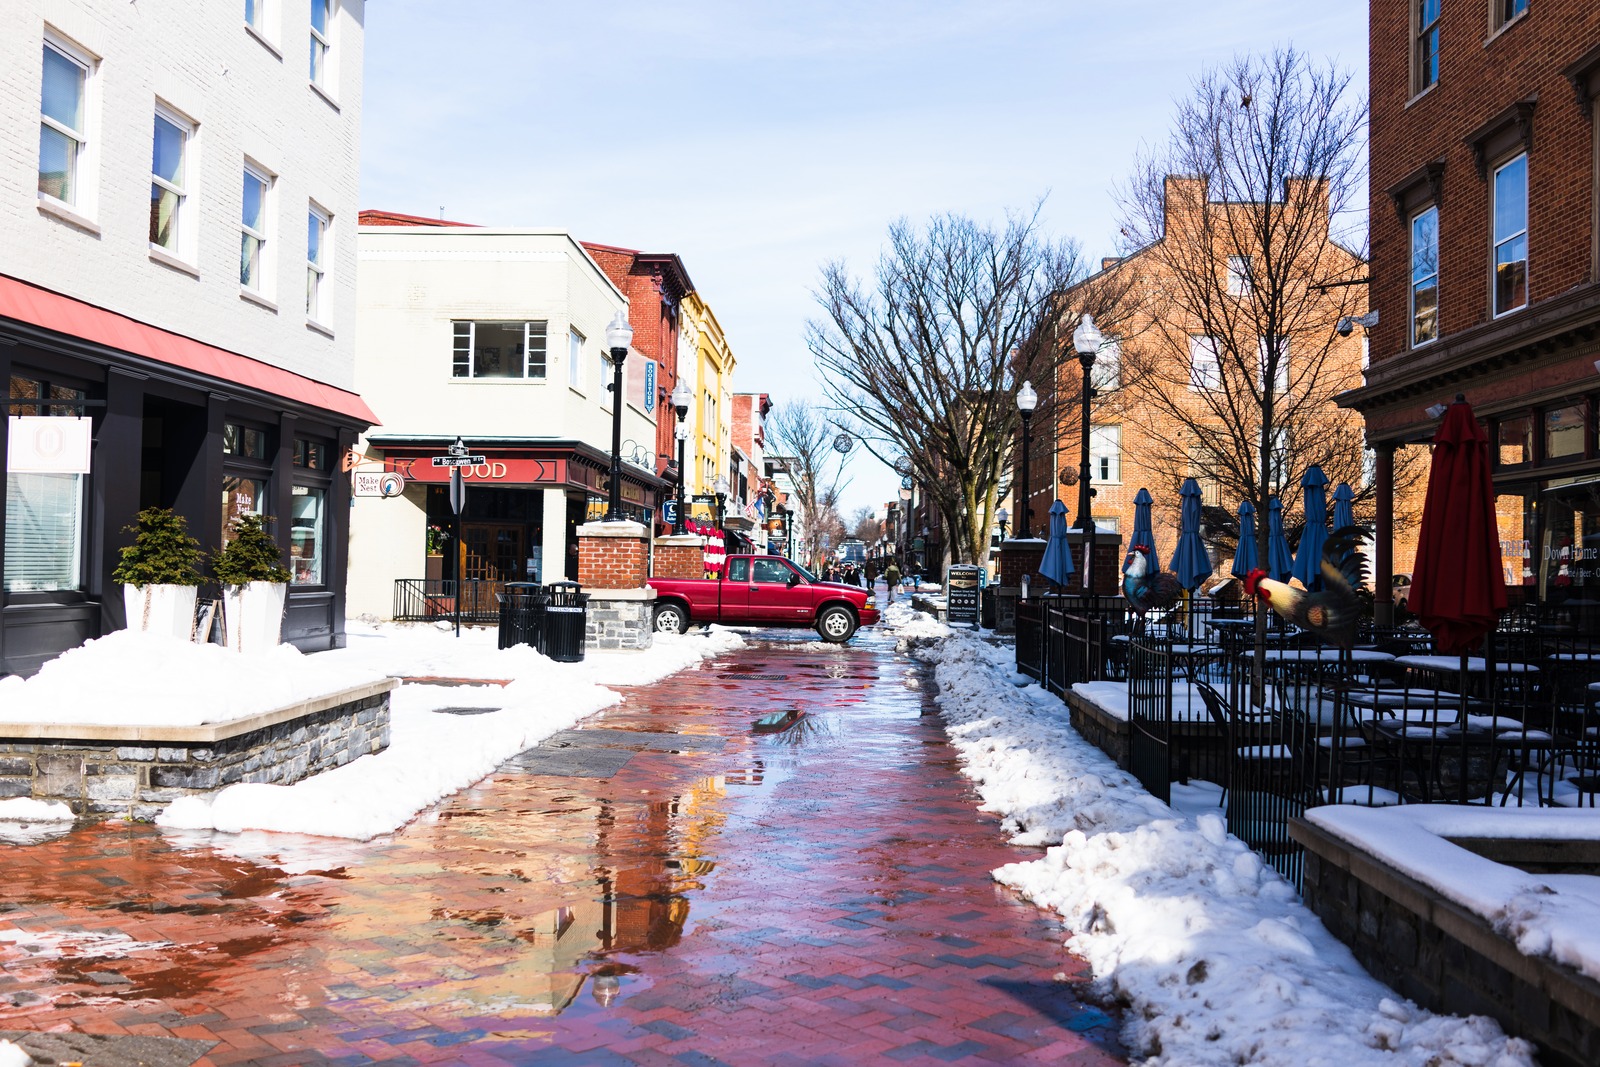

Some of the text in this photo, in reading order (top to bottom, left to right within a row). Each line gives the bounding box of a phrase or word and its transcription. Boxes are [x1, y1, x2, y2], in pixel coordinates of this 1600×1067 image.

[442, 458, 471, 466] Boscawen
[449, 462, 507, 478] FOOD
[358, 476, 379, 485] Make
[360, 484, 377, 492] Nest
[236, 493, 252, 504] Make
[1544, 544, 1598, 561] Down Home
[1580, 568, 1592, 578] Beer
